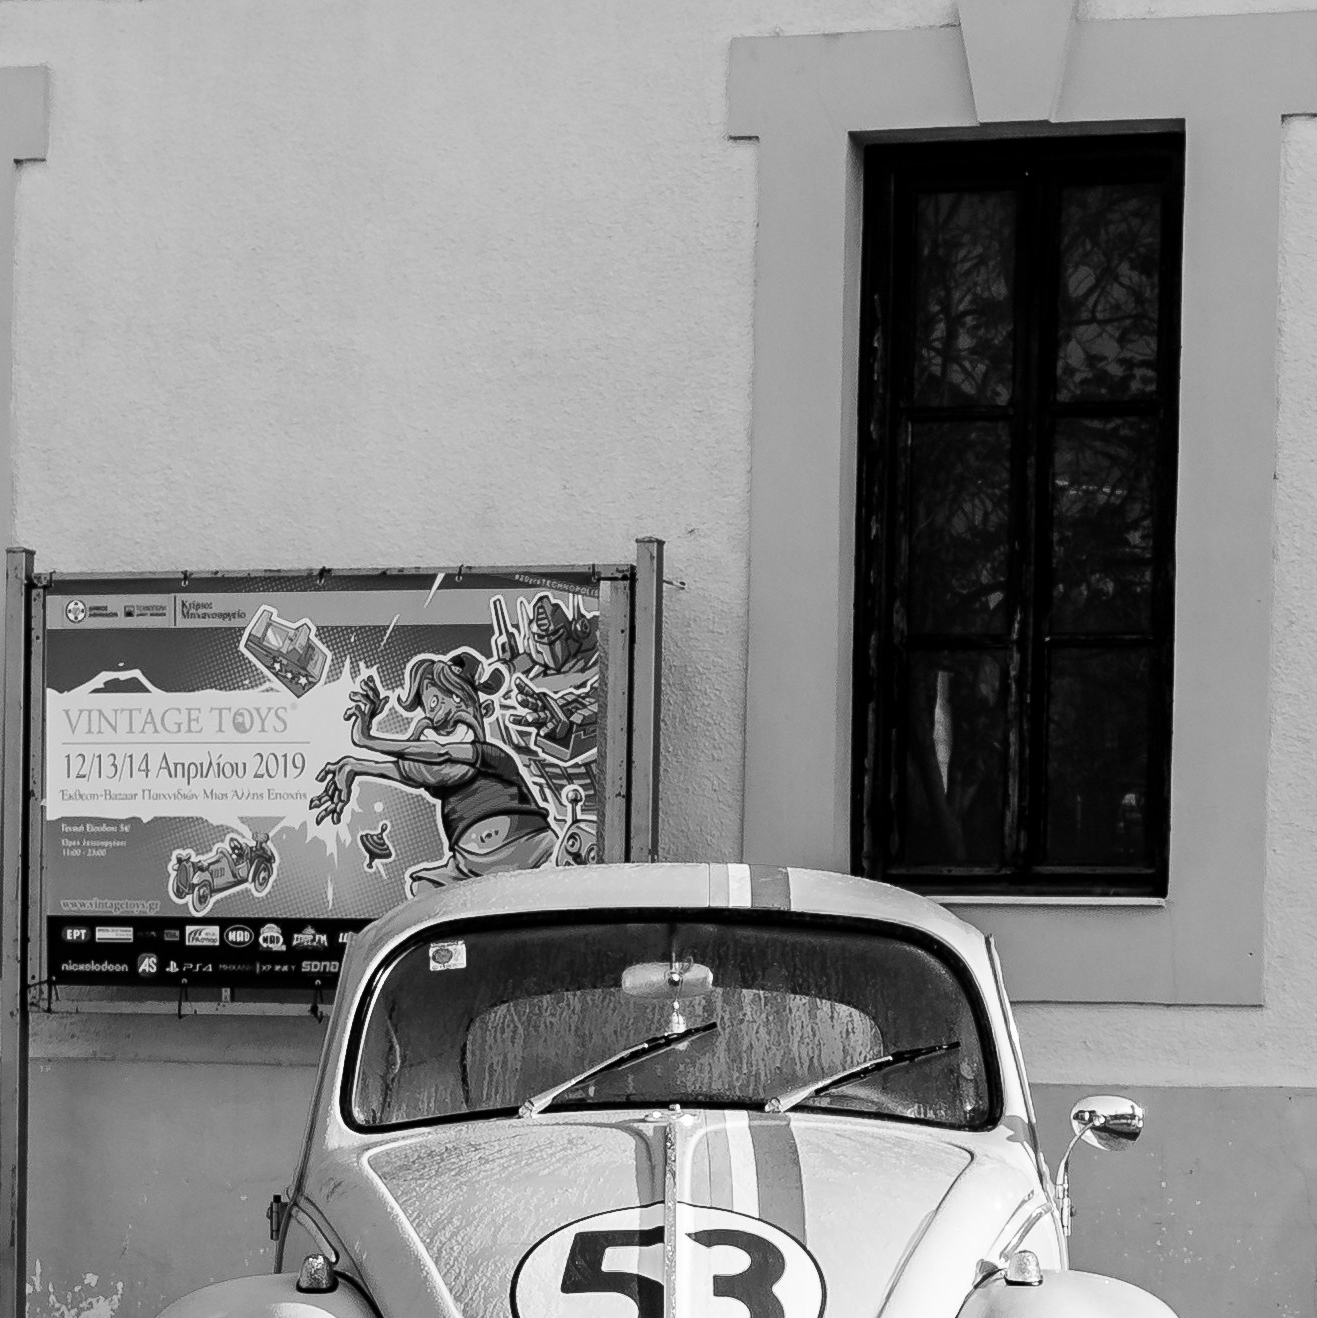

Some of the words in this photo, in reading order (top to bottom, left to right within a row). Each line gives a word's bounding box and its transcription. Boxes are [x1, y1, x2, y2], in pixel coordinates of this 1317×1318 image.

[62, 707, 203, 735] VINTAGE
[64, 752, 150, 782] 12/13/14
[156, 751, 247, 786] Απριλίου
[253, 752, 306, 779] 2019
[61, 960, 129, 972] nickelodeon
[138, 956, 157, 973] AS
